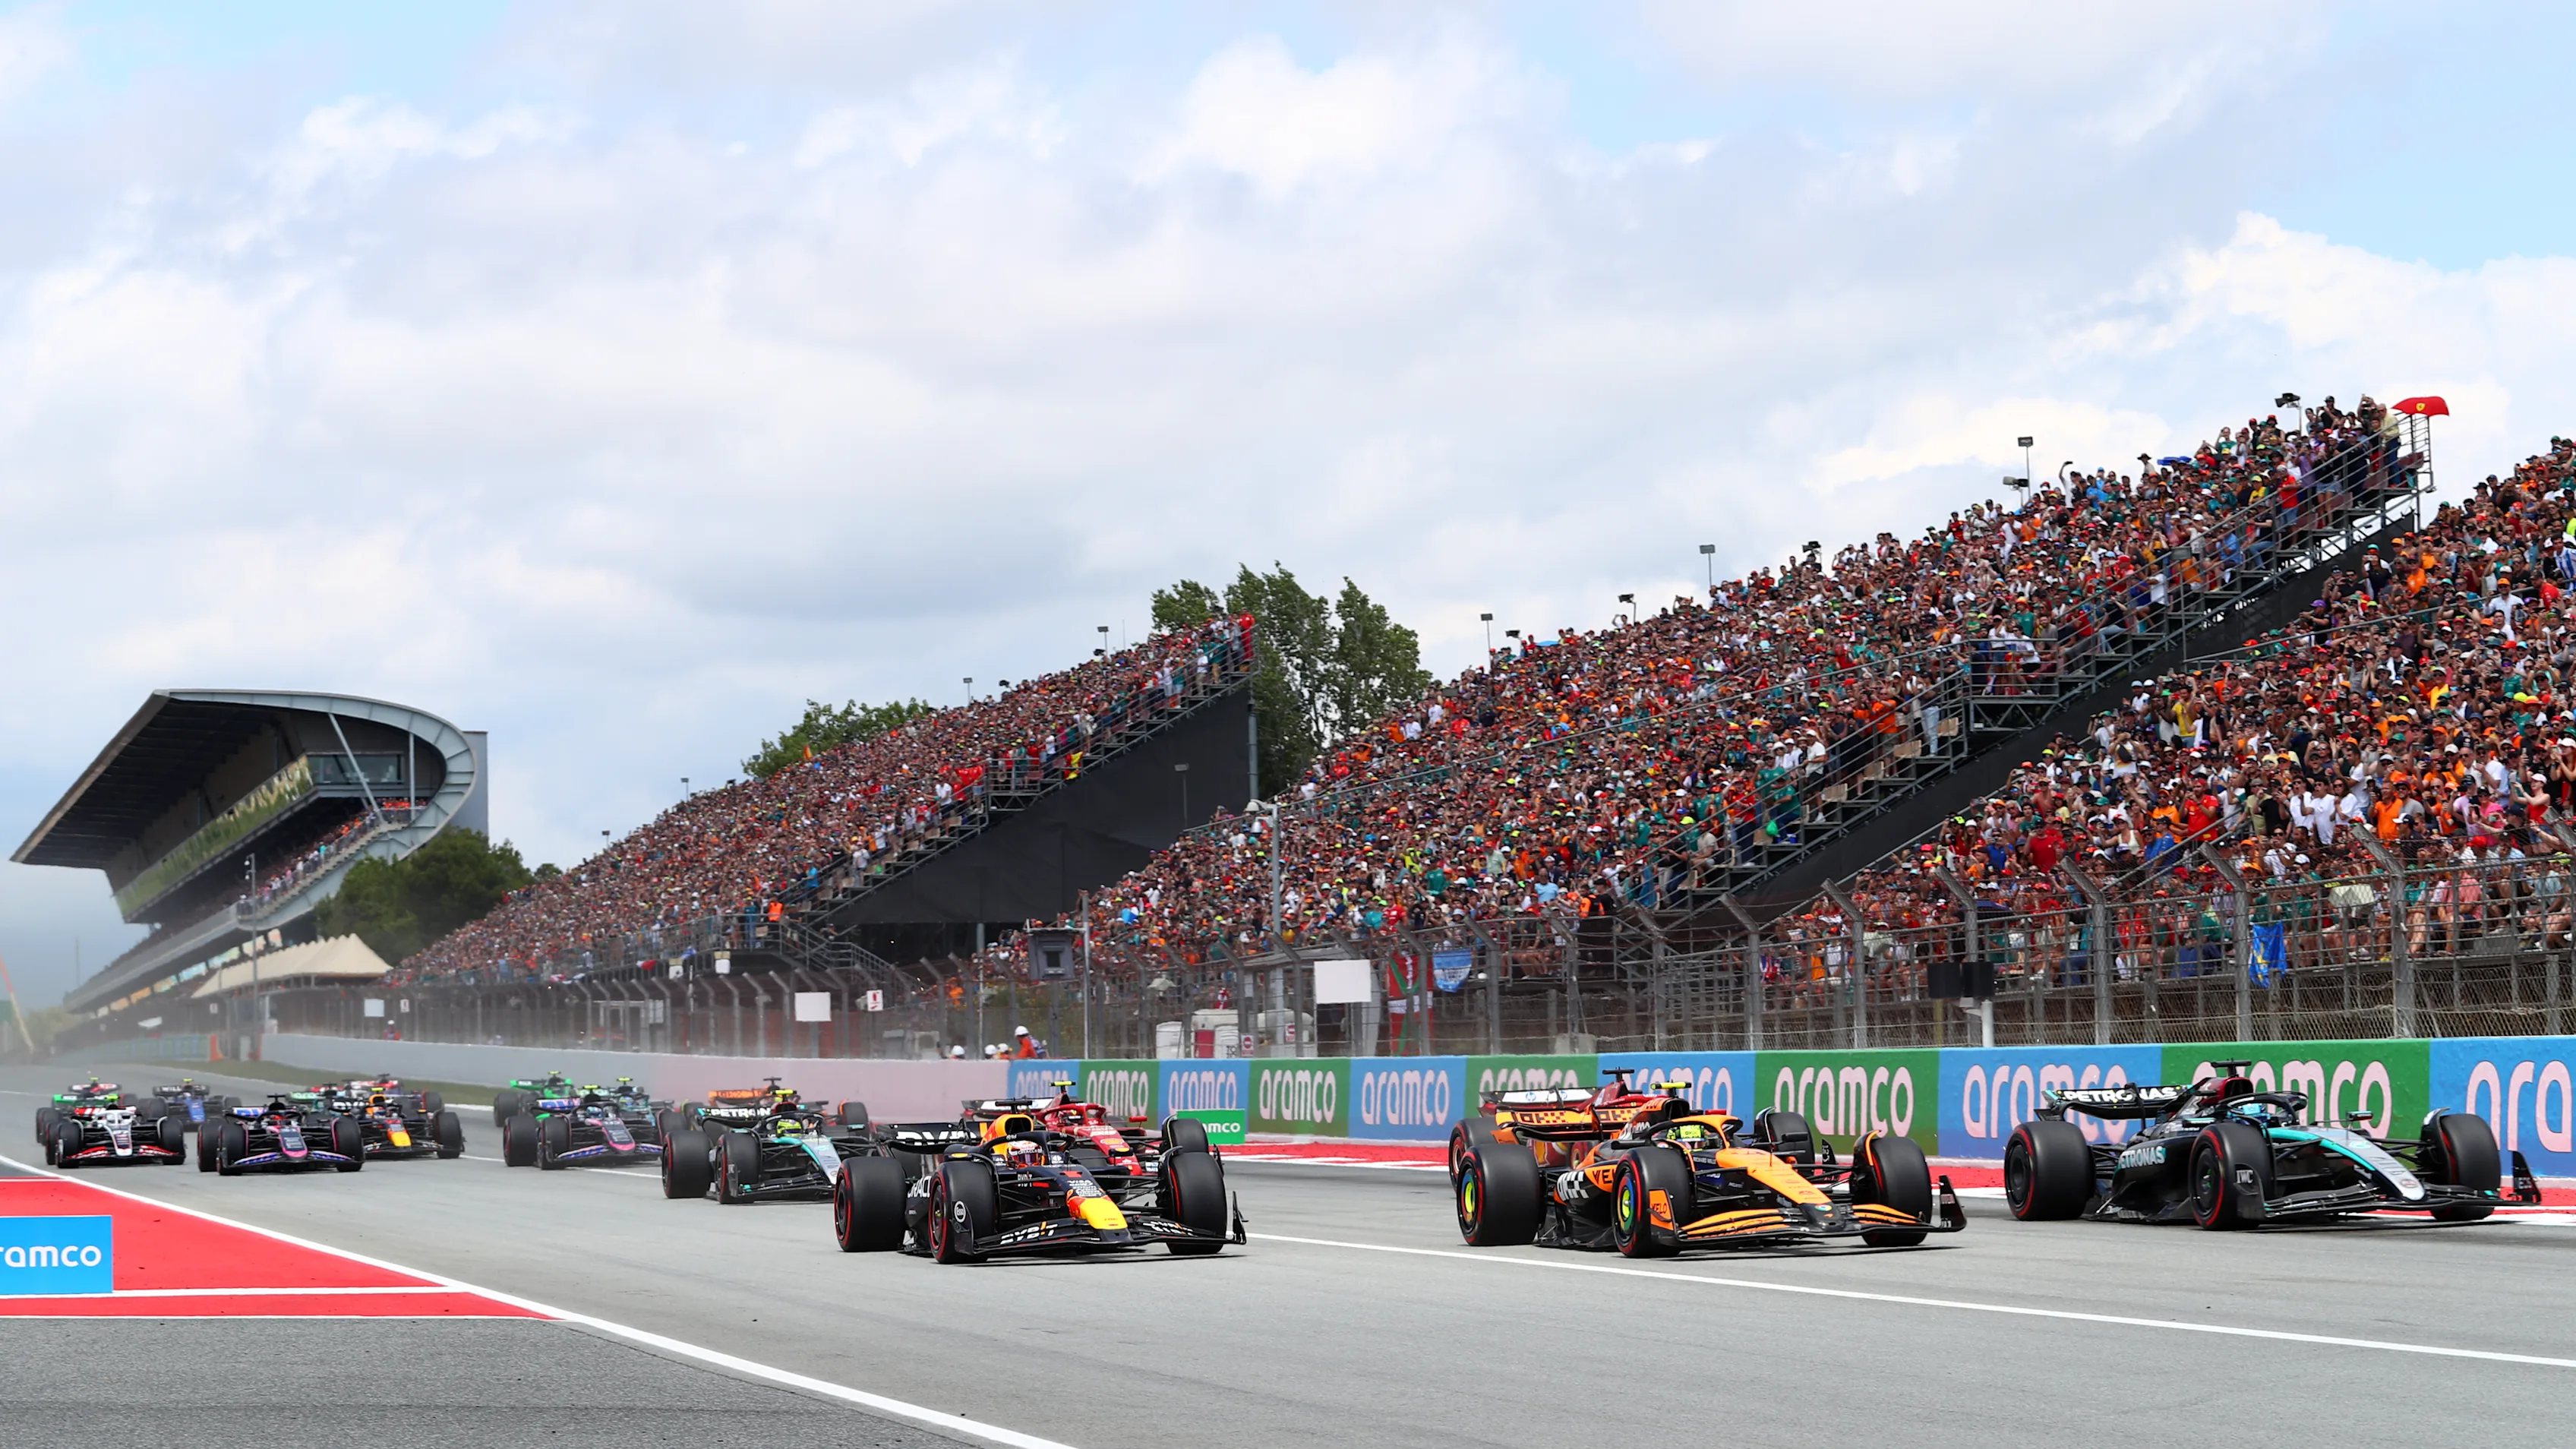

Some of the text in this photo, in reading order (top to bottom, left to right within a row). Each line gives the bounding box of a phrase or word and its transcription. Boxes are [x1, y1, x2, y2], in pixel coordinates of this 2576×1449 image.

[1086, 1070, 1149, 1116] aramco
[1168, 1071, 1237, 1116] aramco
[1259, 1069, 1337, 1123] aramco
[1361, 1069, 1450, 1126] aramco
[1775, 1066, 1914, 1138] aramco
[2063, 1086, 2177, 1103] PETRONAS
[2192, 1060, 2391, 1141] amco
[2119, 1145, 2165, 1169] ETRONAS
[2236, 1170, 2253, 1184] IWC
